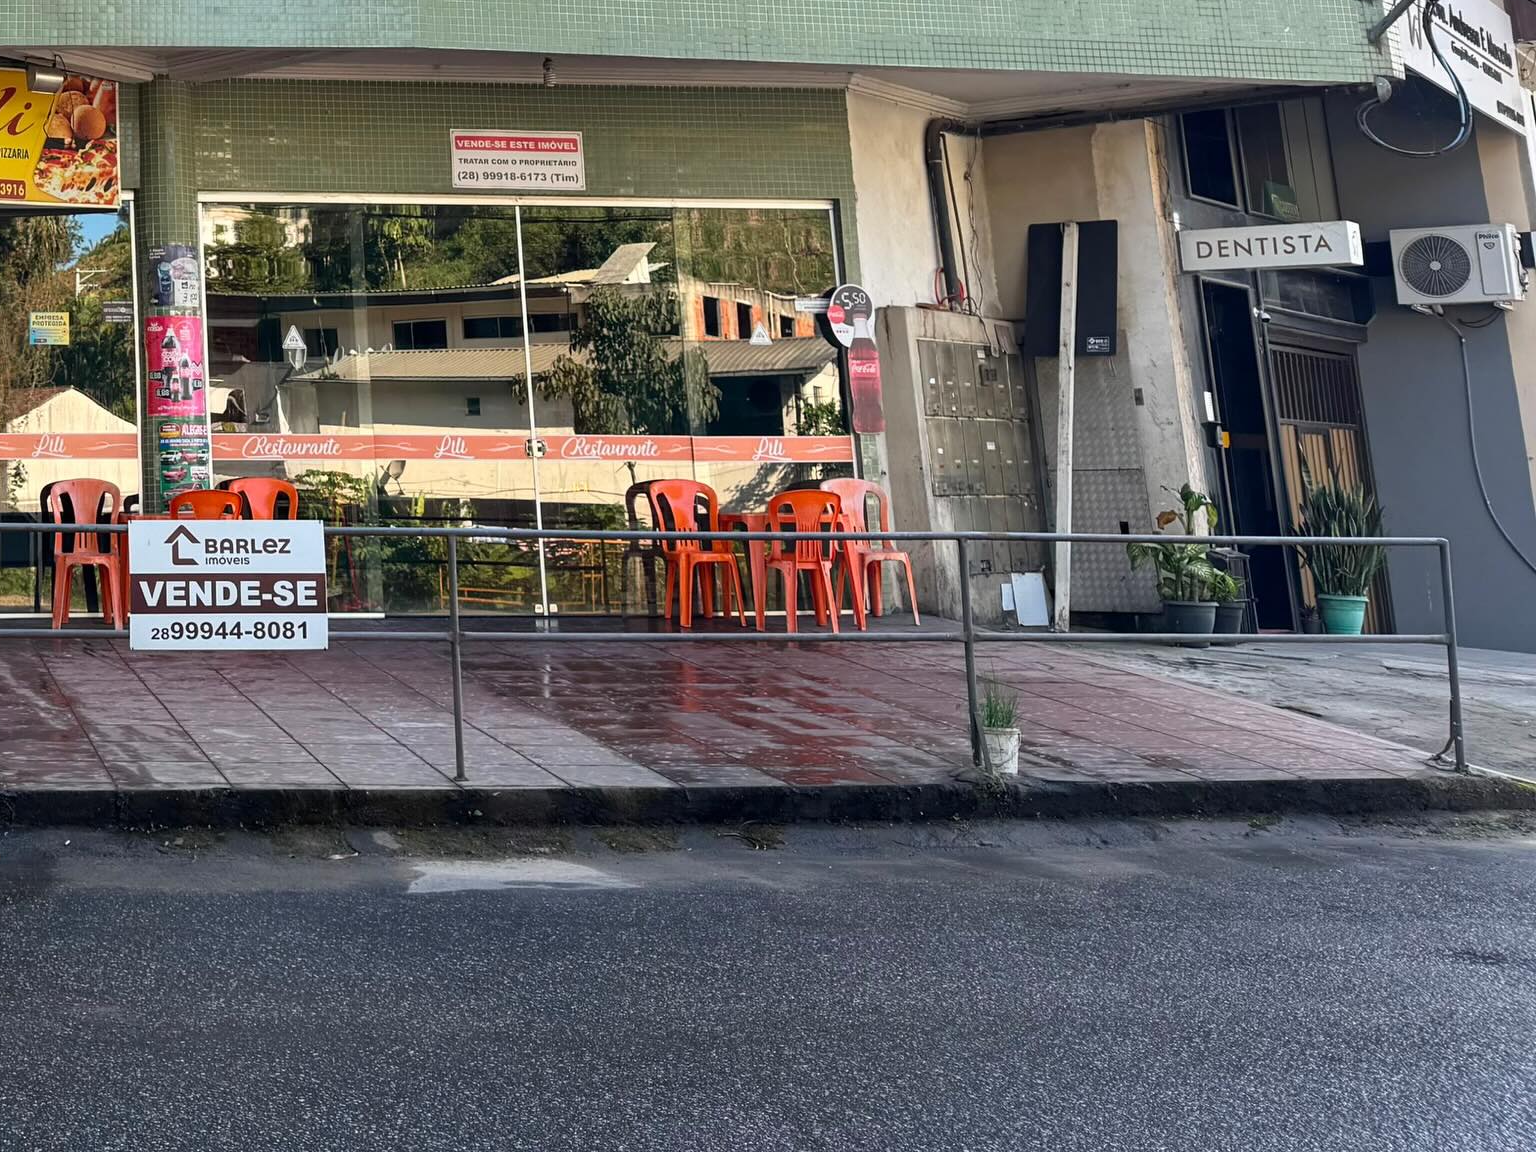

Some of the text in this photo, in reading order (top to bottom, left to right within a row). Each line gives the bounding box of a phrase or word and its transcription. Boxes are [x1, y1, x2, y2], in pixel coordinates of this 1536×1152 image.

[456, 139, 577, 151] VENDE-SE ESTE IMÓVEL
[458, 157, 489, 166] TRATAR
[491, 158, 509, 166] COM
[519, 158, 577, 167] PROPRIETÁRIO
[457, 171, 579, 185] (28) 99918-6173 (Tim)
[1196, 234, 1333, 259] DENTISTA
[242, 435, 343, 459] Restaurante
[561, 436, 661, 460] Restaurante
[139, 580, 318, 608] VENDE-SE
